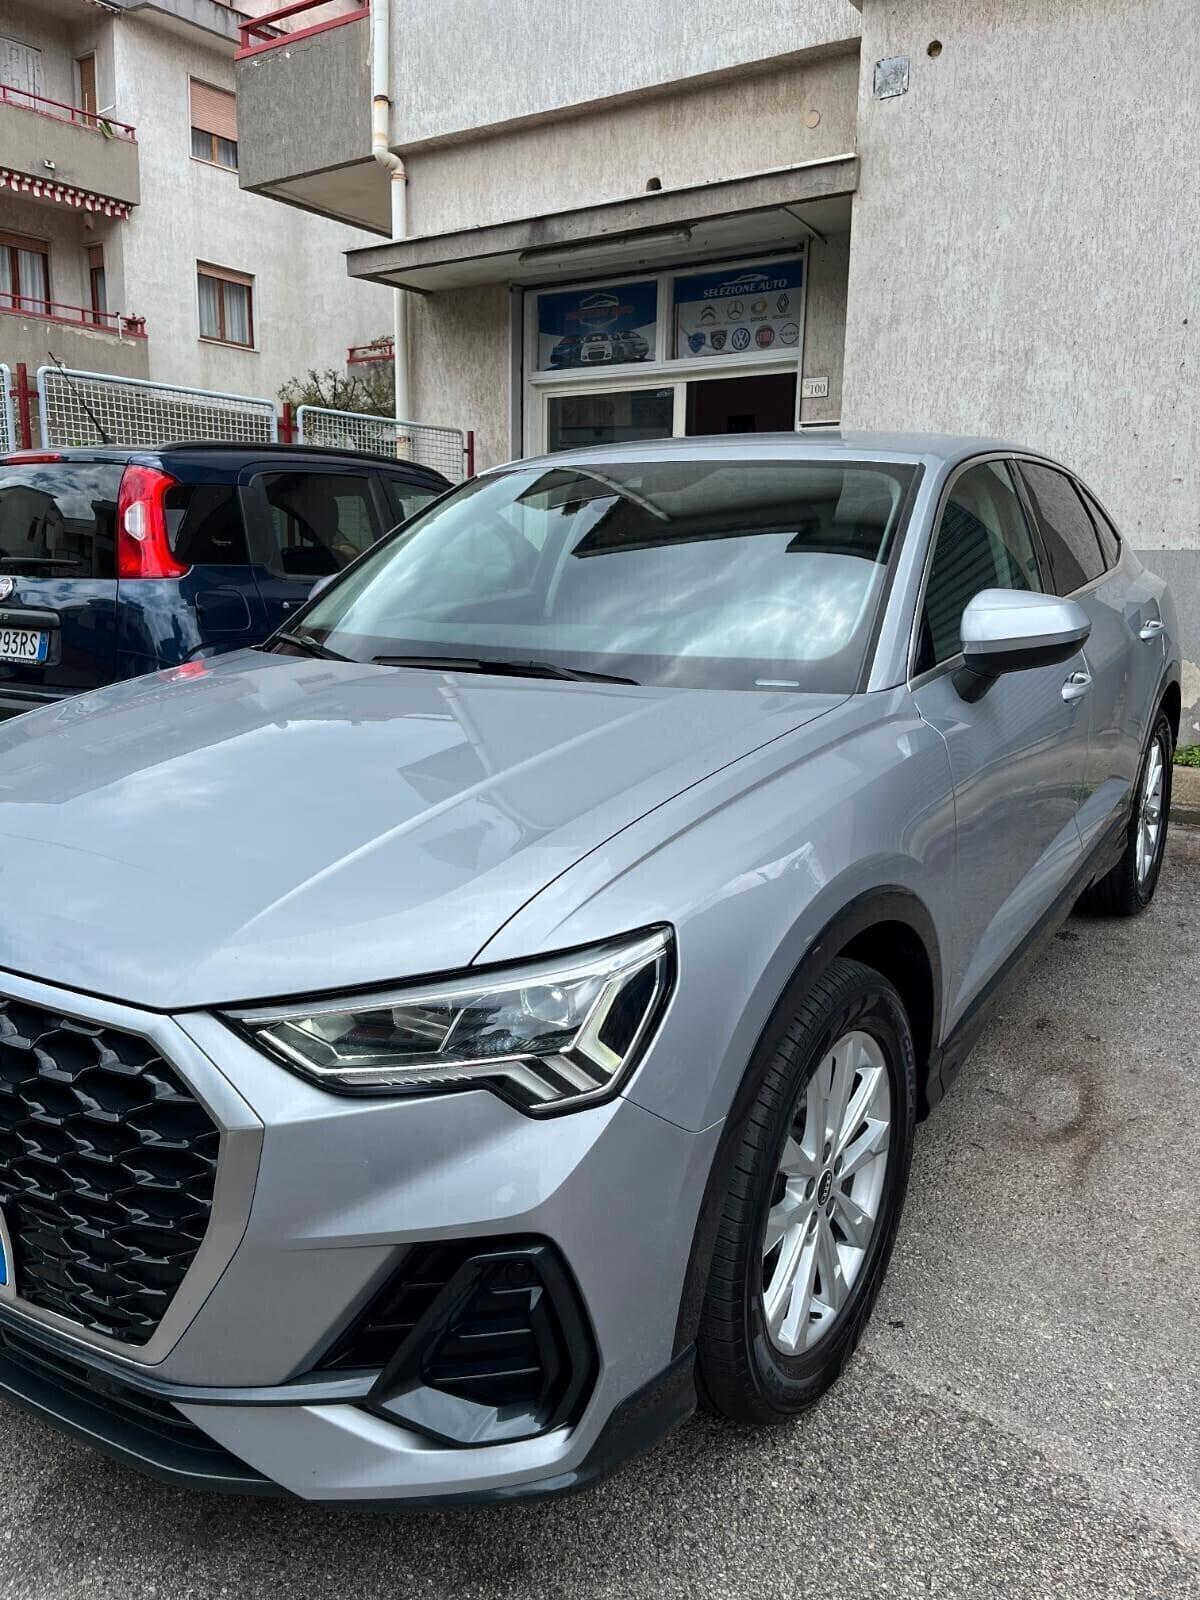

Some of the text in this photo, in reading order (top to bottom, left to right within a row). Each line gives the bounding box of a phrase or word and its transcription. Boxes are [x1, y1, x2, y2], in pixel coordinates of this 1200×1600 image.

[703, 279, 788, 298] SELEZIONE AUTO
[810, 383, 826, 395] 100
